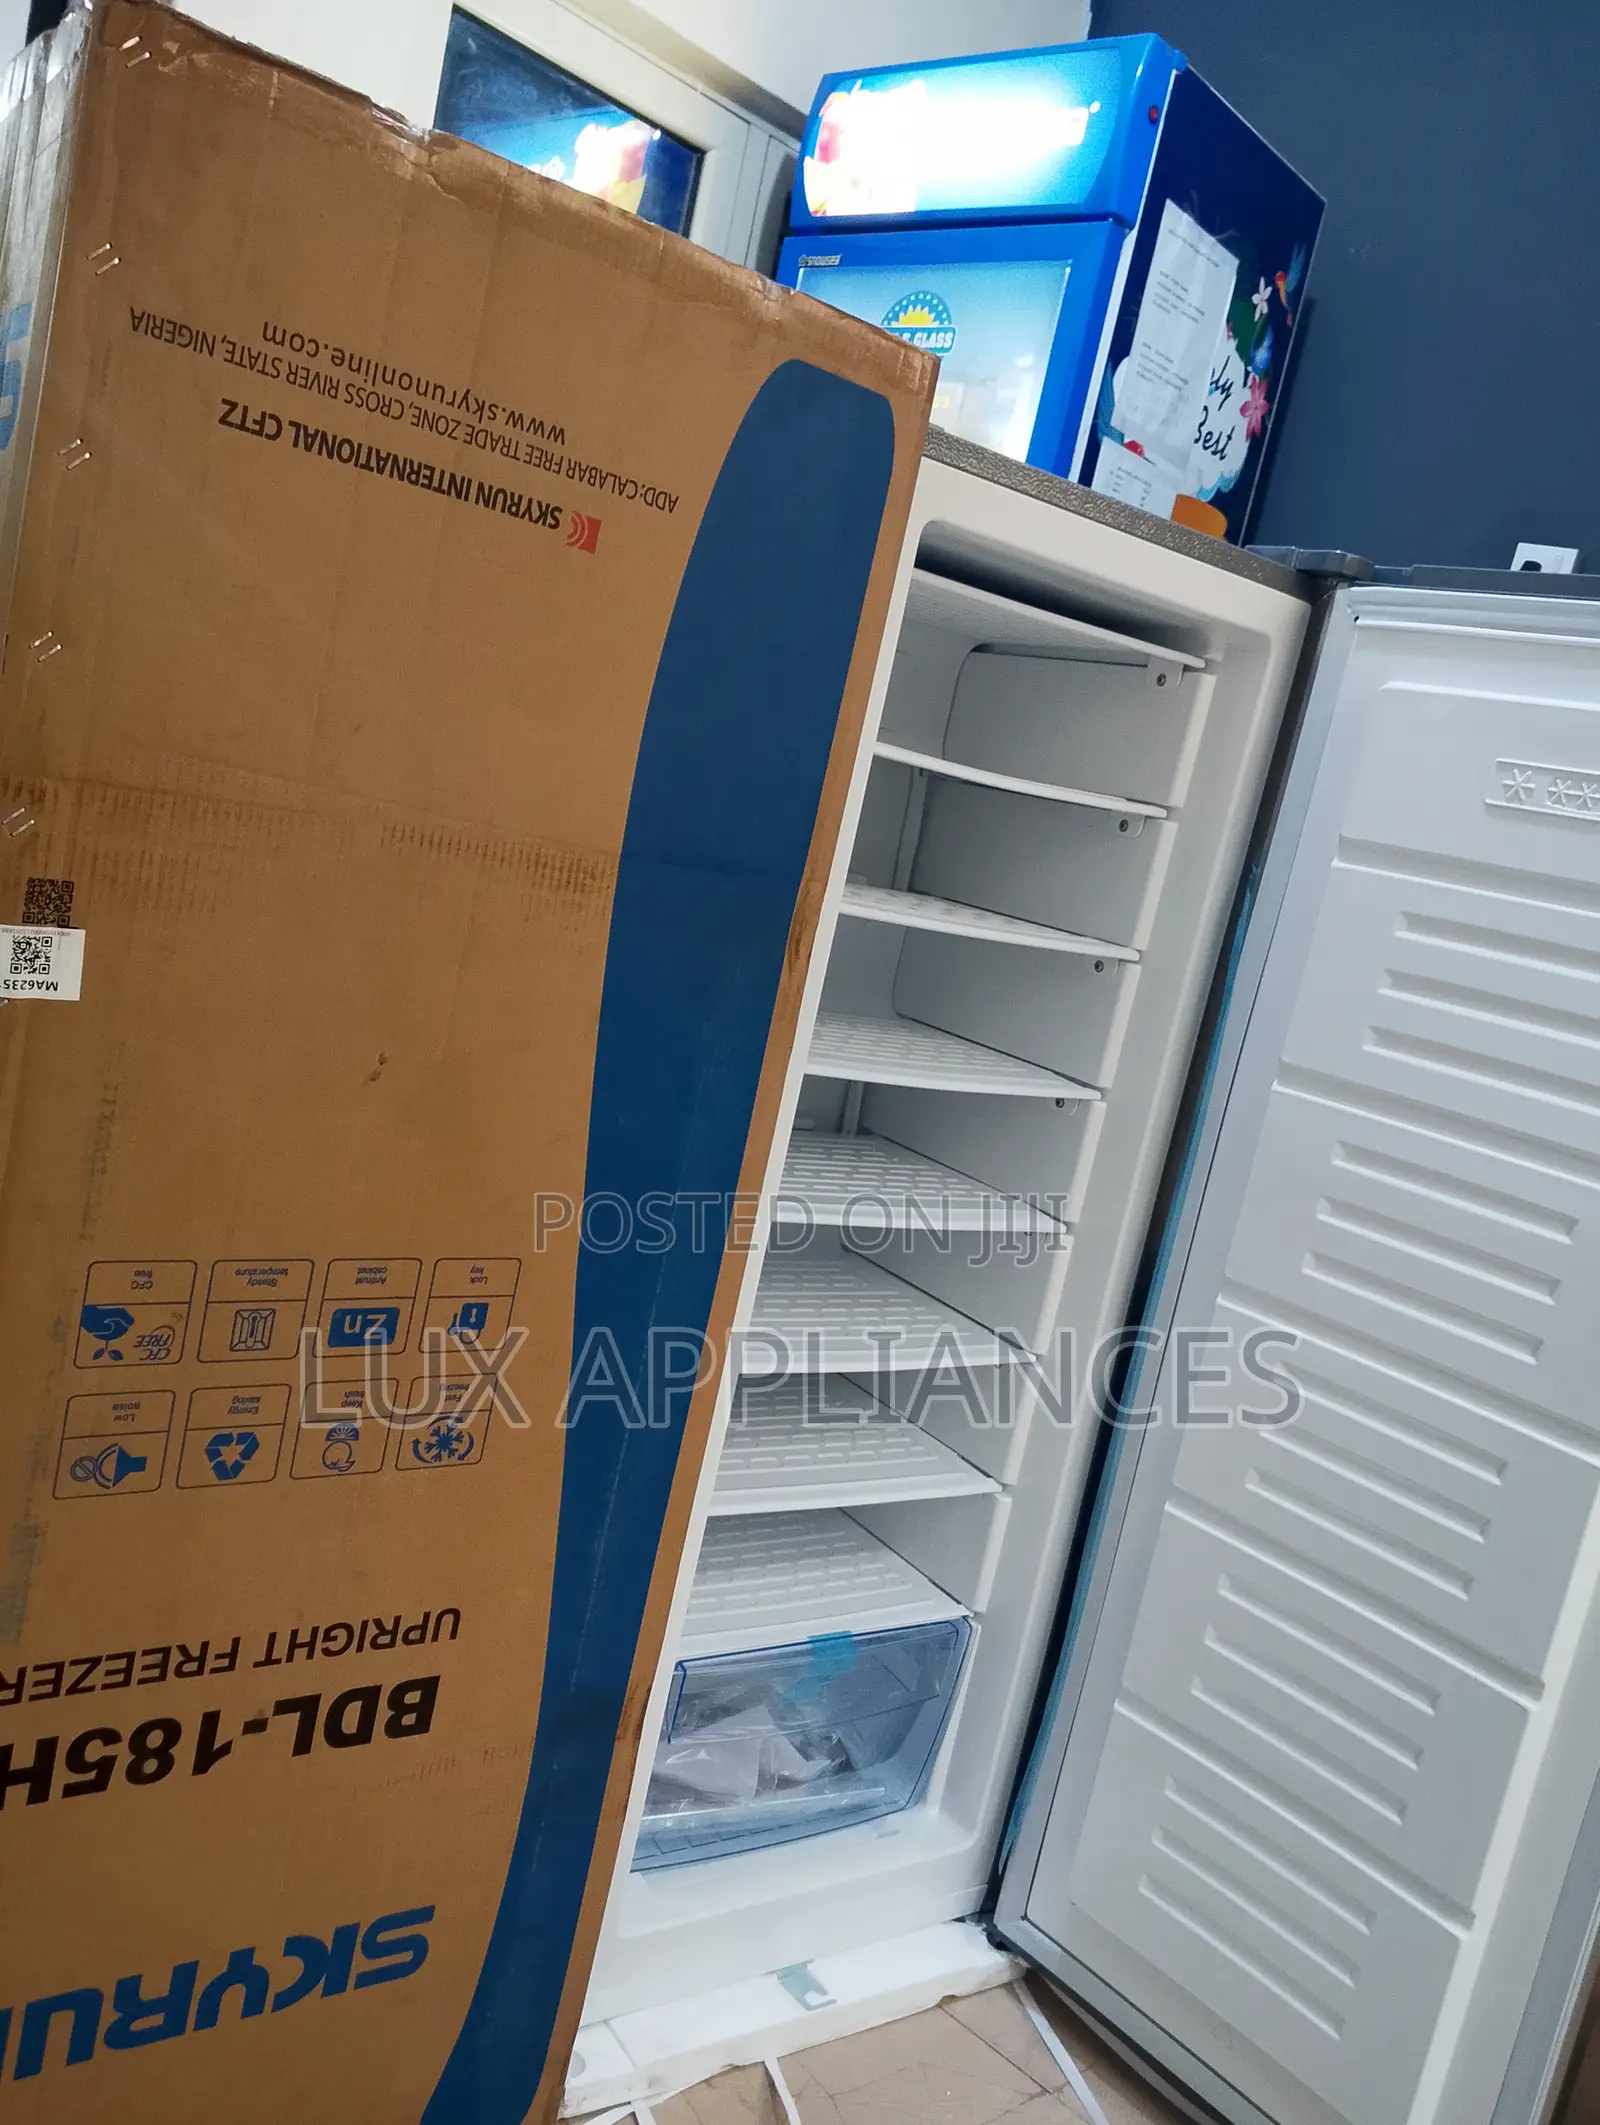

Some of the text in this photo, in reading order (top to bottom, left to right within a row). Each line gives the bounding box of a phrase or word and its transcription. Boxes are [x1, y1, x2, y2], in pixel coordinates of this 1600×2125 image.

[129, 307, 217, 357] NIGERIA
[220, 335, 283, 379] STATE,
[262, 321, 565, 446] www.skyrunonline.com
[286, 361, 340, 399] RIVER
[343, 382, 405, 421] CROSS
[408, 401, 462, 440] ZONE,
[463, 424, 520, 461] TRADE
[218, 398, 563, 530] SKYRUN INTERNATIONAL CFTZ
[523, 444, 564, 475] FREE
[0, 979, 59, 992] MA6235
[235, 1267, 289, 1278] temperature
[357, 1266, 387, 1276] cabinet
[469, 1265, 484, 1276] key
[131, 1280, 153, 1290] CFC
[246, 1276, 278, 1288] Steady
[355, 1276, 387, 1286] Antirust
[469, 1275, 488, 1285] Lock
[344, 1313, 387, 1340] Zn
[133, 1333, 171, 1347] FREE
[139, 1347, 171, 1360] CFC
[232, 1395, 261, 1405] saving
[344, 1389, 365, 1400] fresh
[112, 1402, 140, 1412] noise
[341, 1398, 363, 1409] Keep
[227, 1405, 259, 1416] Energy
[113, 1413, 135, 1423] Low
[0, 1607, 462, 1707] UPRIGHT FREEZER
[0, 1675, 441, 1812] BDL-185H
[0, 1904, 436, 2082] SKYRU
